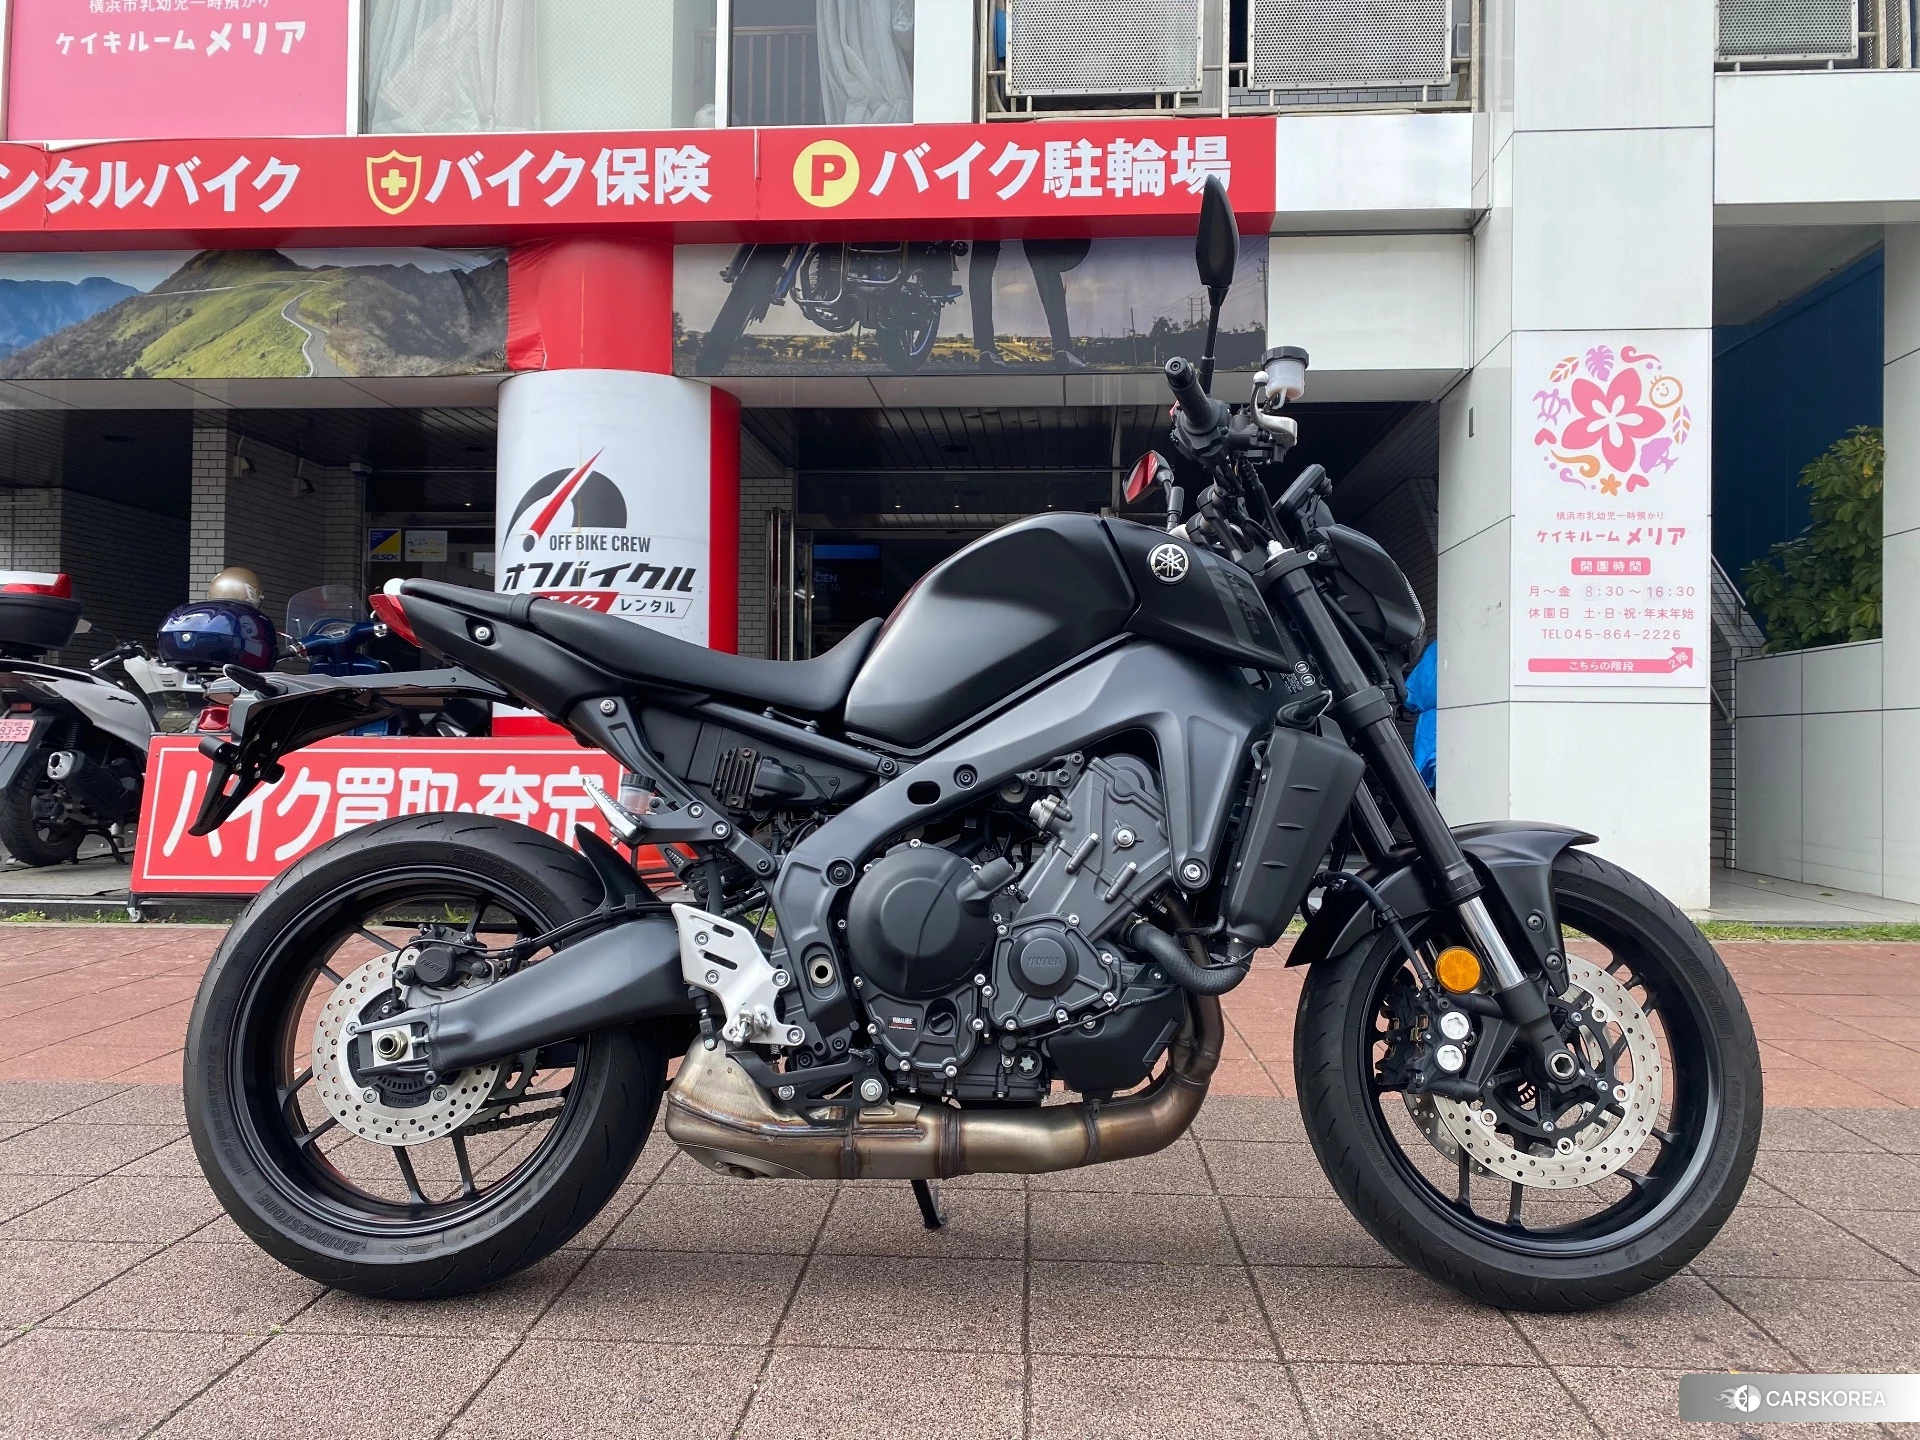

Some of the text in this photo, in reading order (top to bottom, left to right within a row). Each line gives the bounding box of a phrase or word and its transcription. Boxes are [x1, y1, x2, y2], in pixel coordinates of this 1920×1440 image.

[55, 21, 306, 57] ケイキルーム メリア
[424, 144, 712, 207] バイク保険
[810, 154, 847, 197] P
[868, 135, 1231, 200] バイク駐輪場
[1556, 511, 1664, 521] 横浜市乳幼児一時預かり
[549, 534, 651, 553] OFF BIKE CREW
[1536, 527, 1686, 545] ケイキルーム メリア
[1580, 560, 1642, 573] 開園時間
[501, 560, 697, 592] オフバイクル
[620, 598, 676, 614] レンタル
[1528, 607, 1569, 619] 休園日
[1569, 660, 1635, 672] こちらの階段
[1026, 956, 1061, 967] YAMAHA
[253, 1192, 364, 1257] BRIDGESTONE
